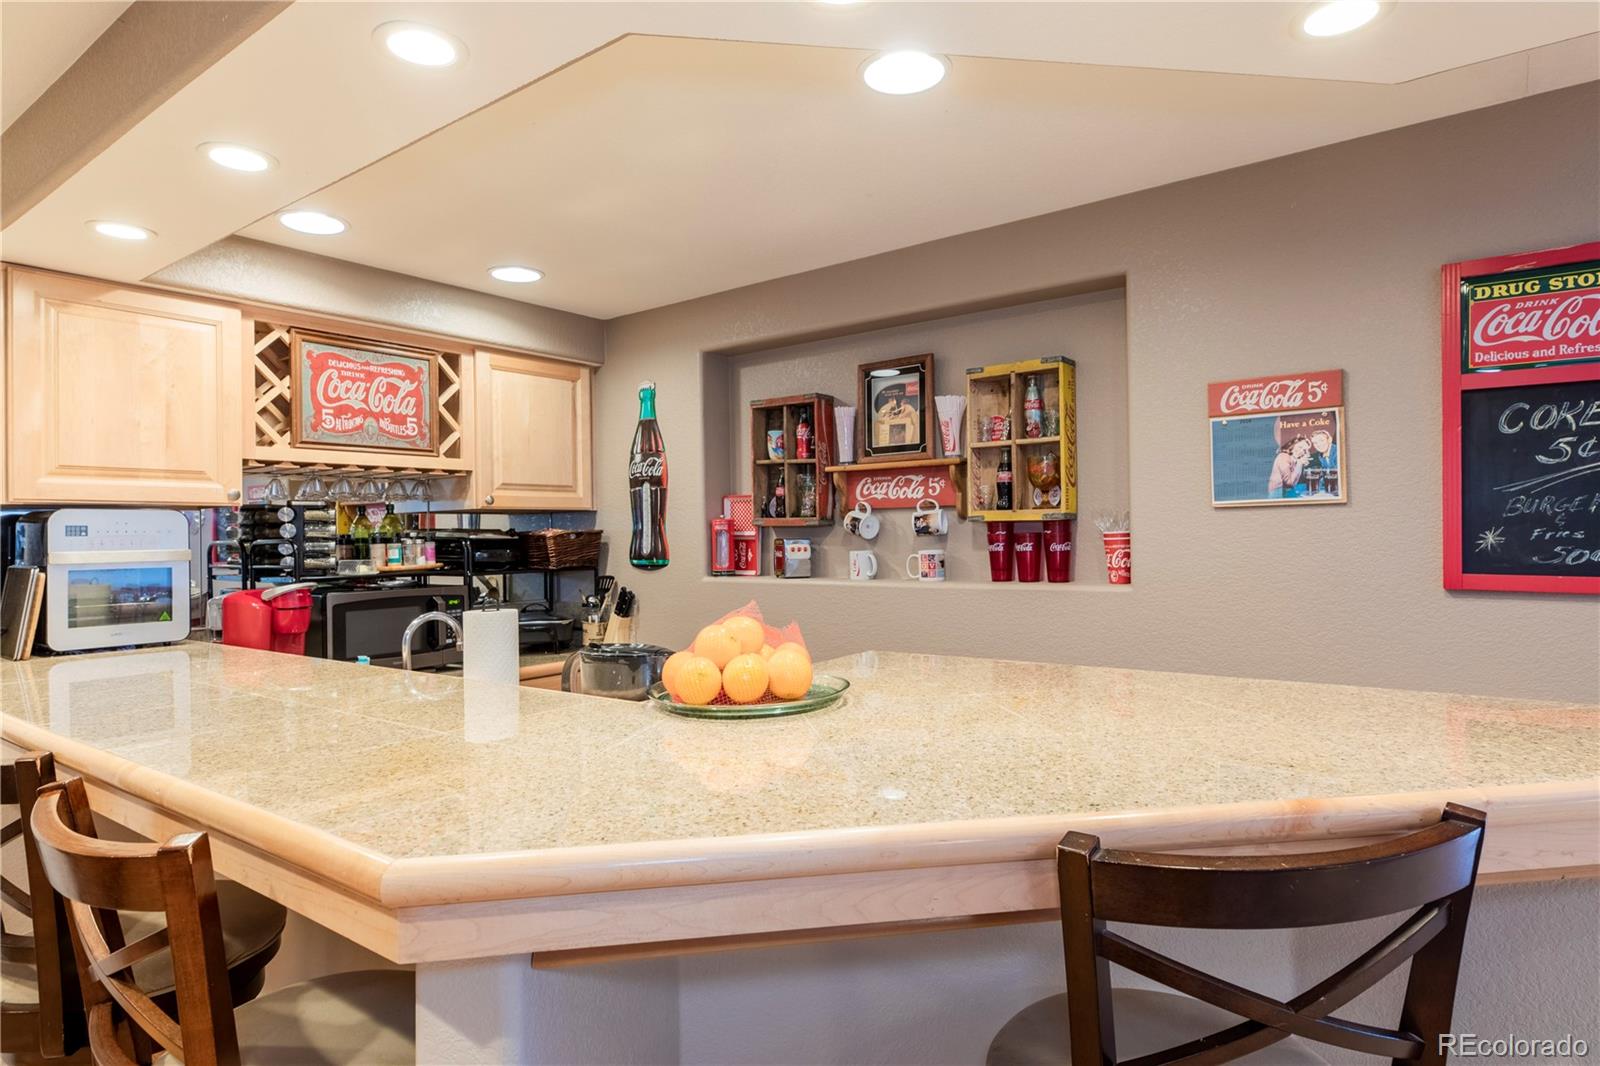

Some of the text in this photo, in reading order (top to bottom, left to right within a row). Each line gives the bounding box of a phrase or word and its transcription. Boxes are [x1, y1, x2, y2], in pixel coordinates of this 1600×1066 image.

[1475, 273, 1600, 300] DRUG STO
[1515, 297, 1559, 309] DRINK
[327, 359, 361, 370] DELICIOUS
[1474, 350, 1529, 363] Delicious
[1532, 345, 1556, 357] and
[1220, 379, 1328, 414] Coca-Cola 5¢
[1280, 421, 1300, 429] Have
[1309, 418, 1330, 426] Coke
[1498, 400, 1600, 434] COKE
[629, 456, 664, 479] Coca-Cola
[855, 475, 946, 501] Coca-Cola 5¢
